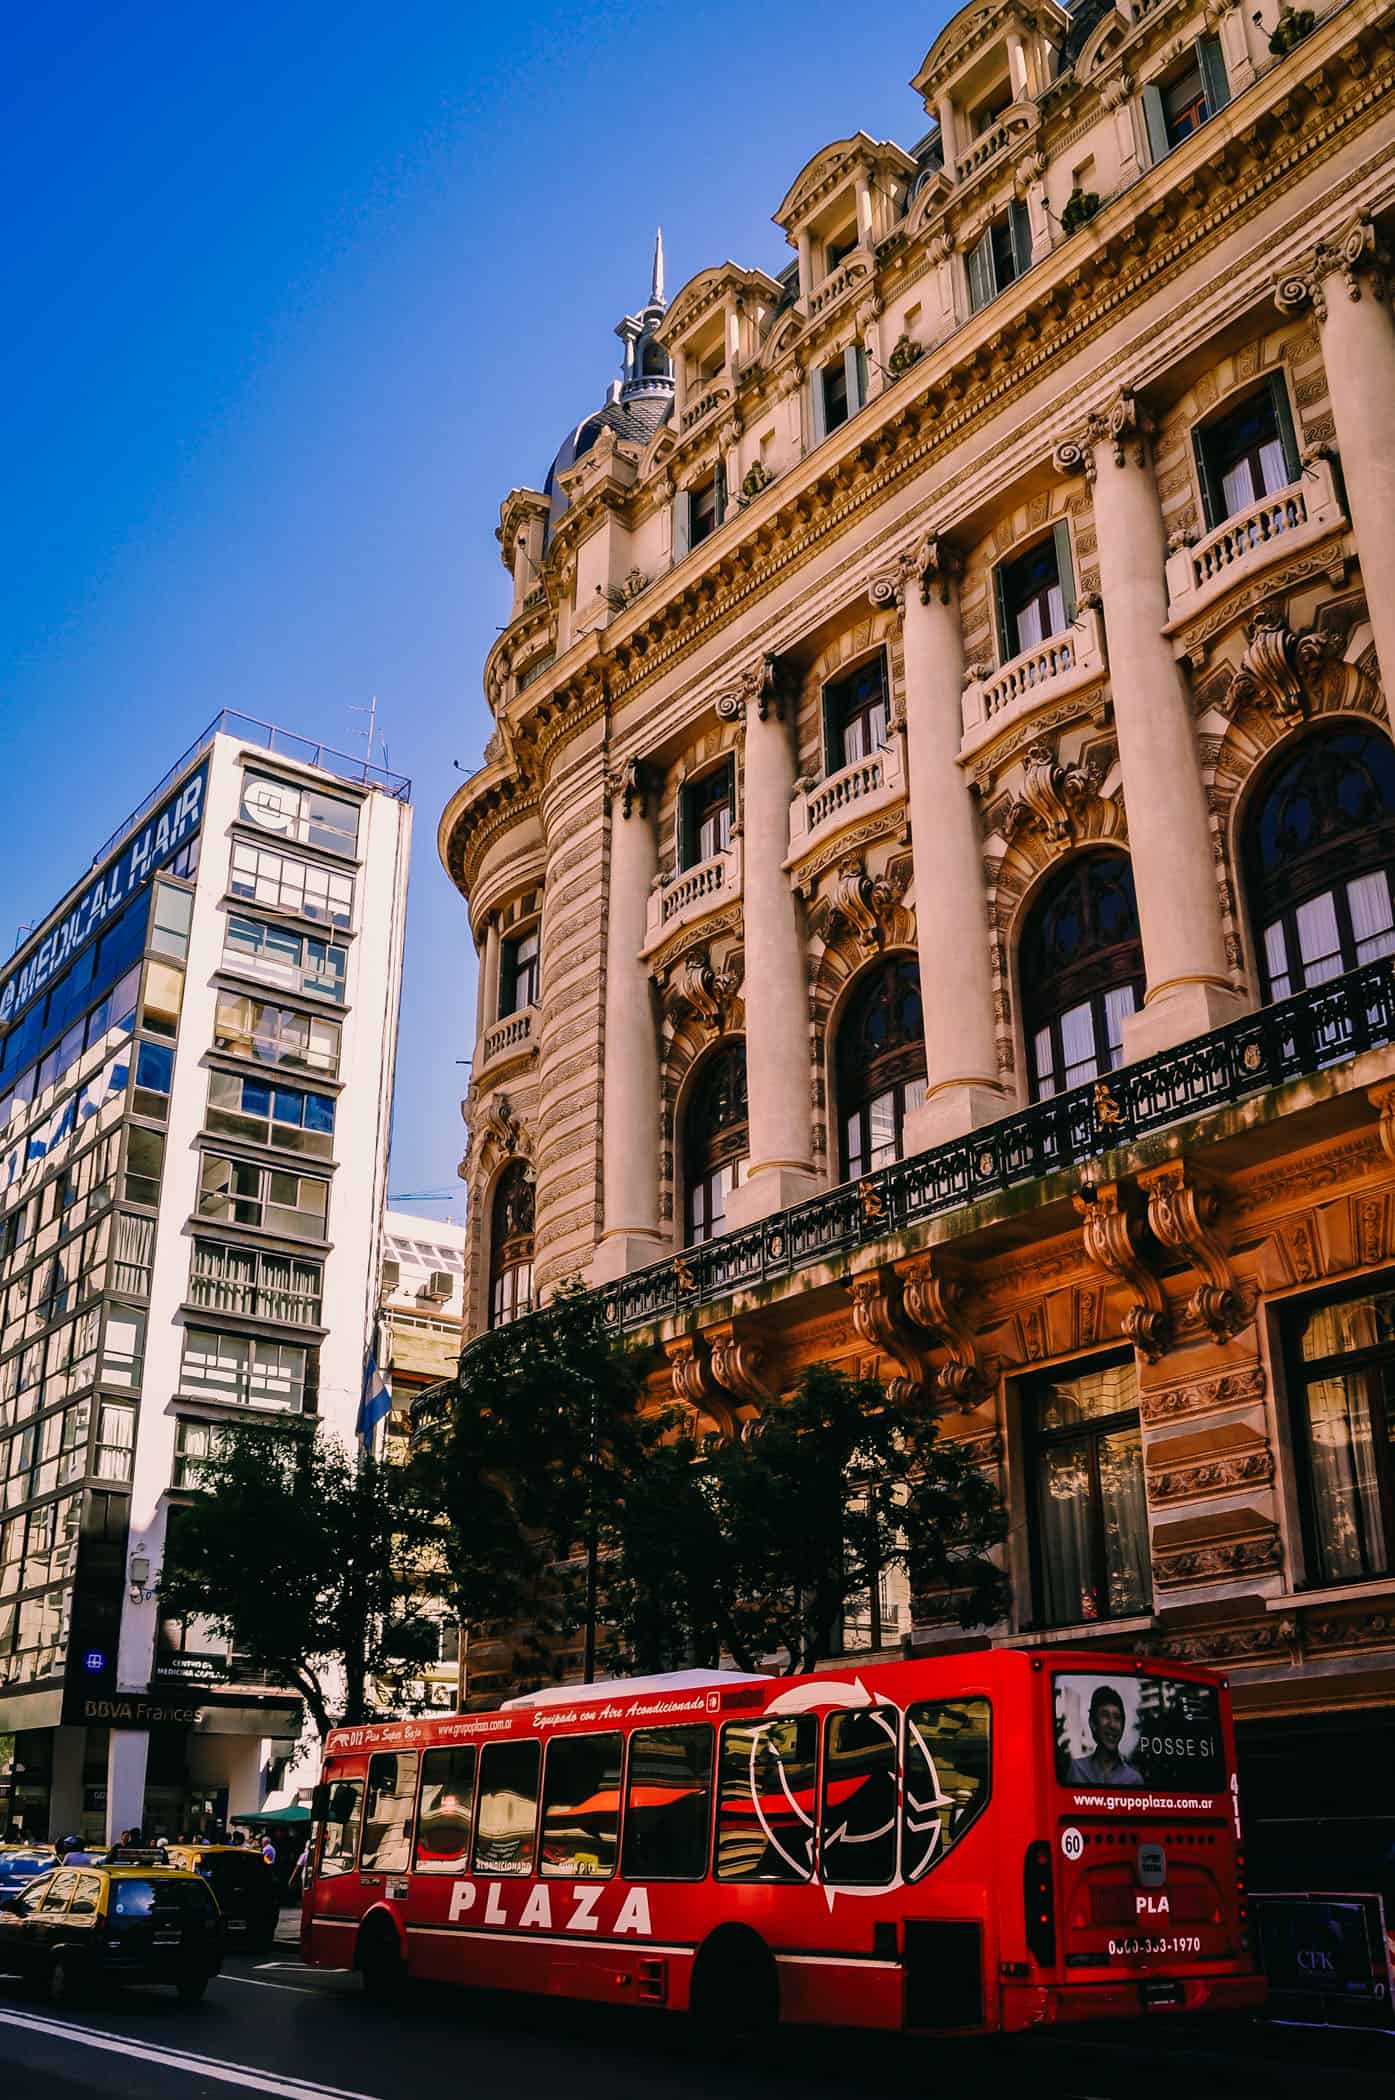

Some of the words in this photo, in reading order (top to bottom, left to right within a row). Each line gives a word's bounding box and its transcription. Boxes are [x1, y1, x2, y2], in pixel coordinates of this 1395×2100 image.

[14, 867, 122, 1012] MEDICAL
[128, 775, 202, 890] HAIR
[85, 1701, 132, 1718] BBVA
[532, 1711, 577, 1729] Equipado
[580, 1712, 595, 1721] con
[598, 1704, 622, 1721] Aire
[625, 1696, 705, 1717] Acondicionado
[438, 1719, 513, 1738] www.grupoplaza.com.ar
[1140, 1736, 1196, 1756] POSSE
[1073, 1794, 1214, 1810] www.grupoplaza.com.ar
[1065, 1835, 1080, 1853] 60
[447, 1880, 652, 1935] PLAZA
[1136, 1896, 1169, 1914] PLA
